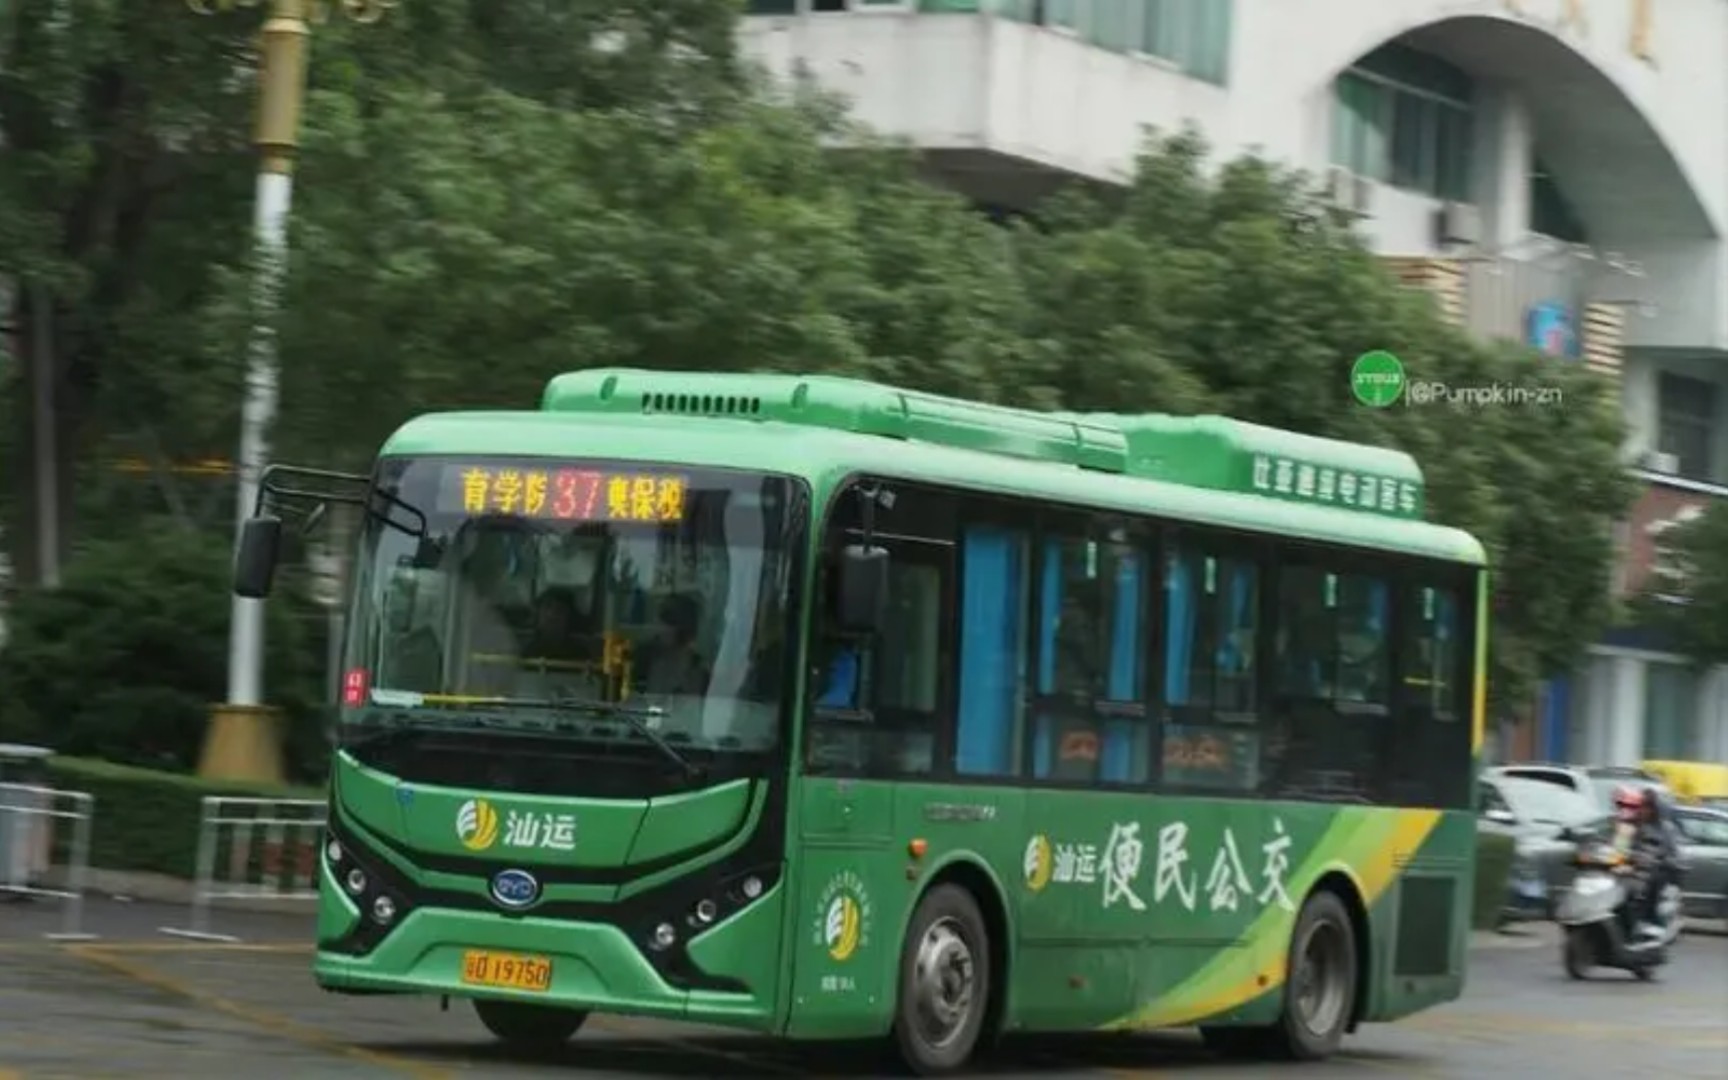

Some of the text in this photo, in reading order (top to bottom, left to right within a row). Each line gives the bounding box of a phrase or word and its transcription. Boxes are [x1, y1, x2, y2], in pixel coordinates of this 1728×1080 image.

[553, 470, 602, 518] 37
[503, 809, 577, 850] 汕运
[1052, 844, 1098, 882] 汕运
[1099, 816, 1296, 912] 便民公交
